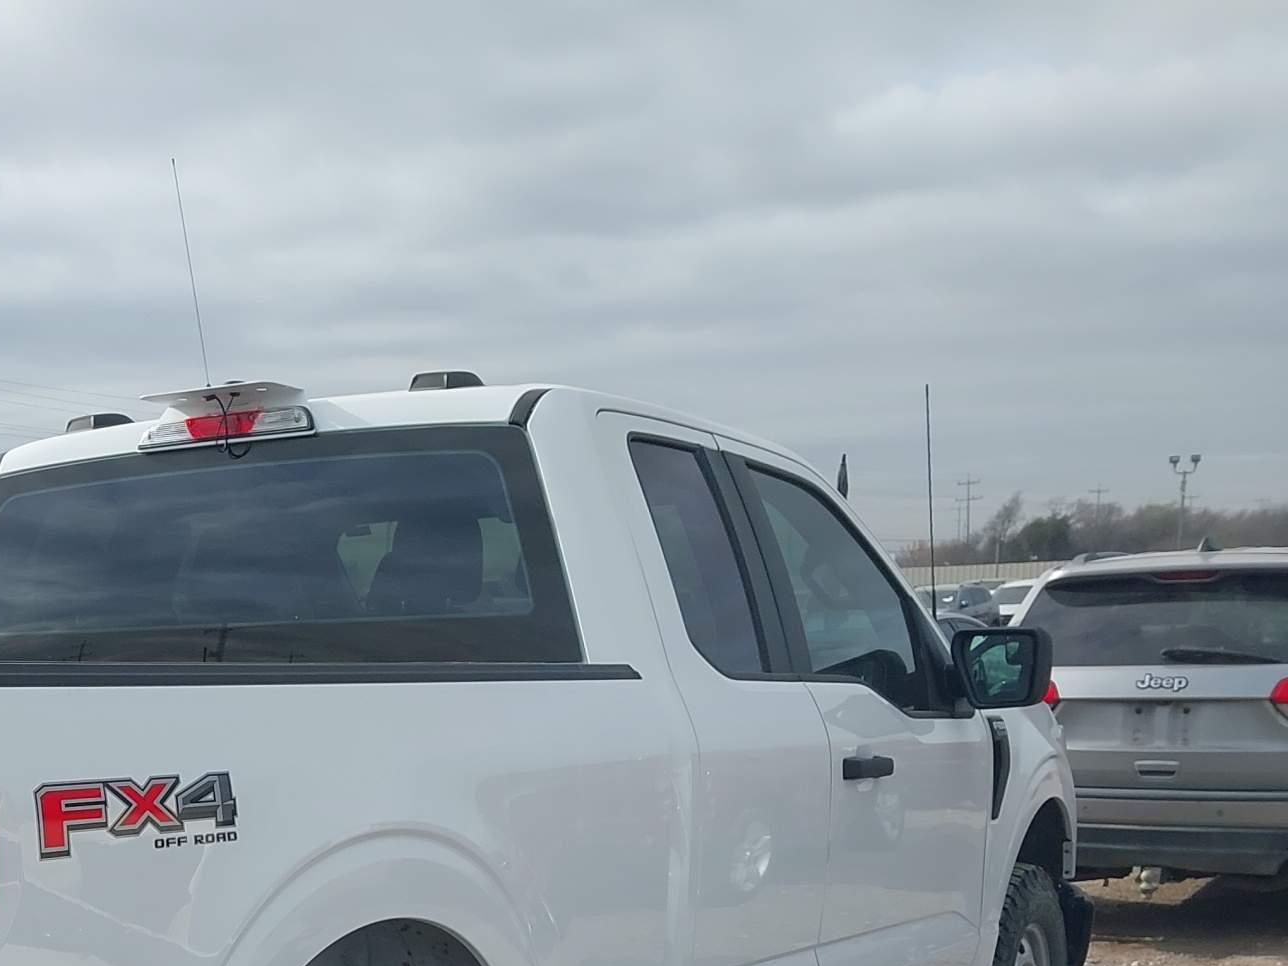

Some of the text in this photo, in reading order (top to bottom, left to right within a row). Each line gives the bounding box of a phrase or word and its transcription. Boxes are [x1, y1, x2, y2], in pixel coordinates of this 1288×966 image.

[1136, 673, 1189, 692] Jeep
[32, 770, 238, 861] FX4
[154, 831, 238, 849] OFF ROAD
